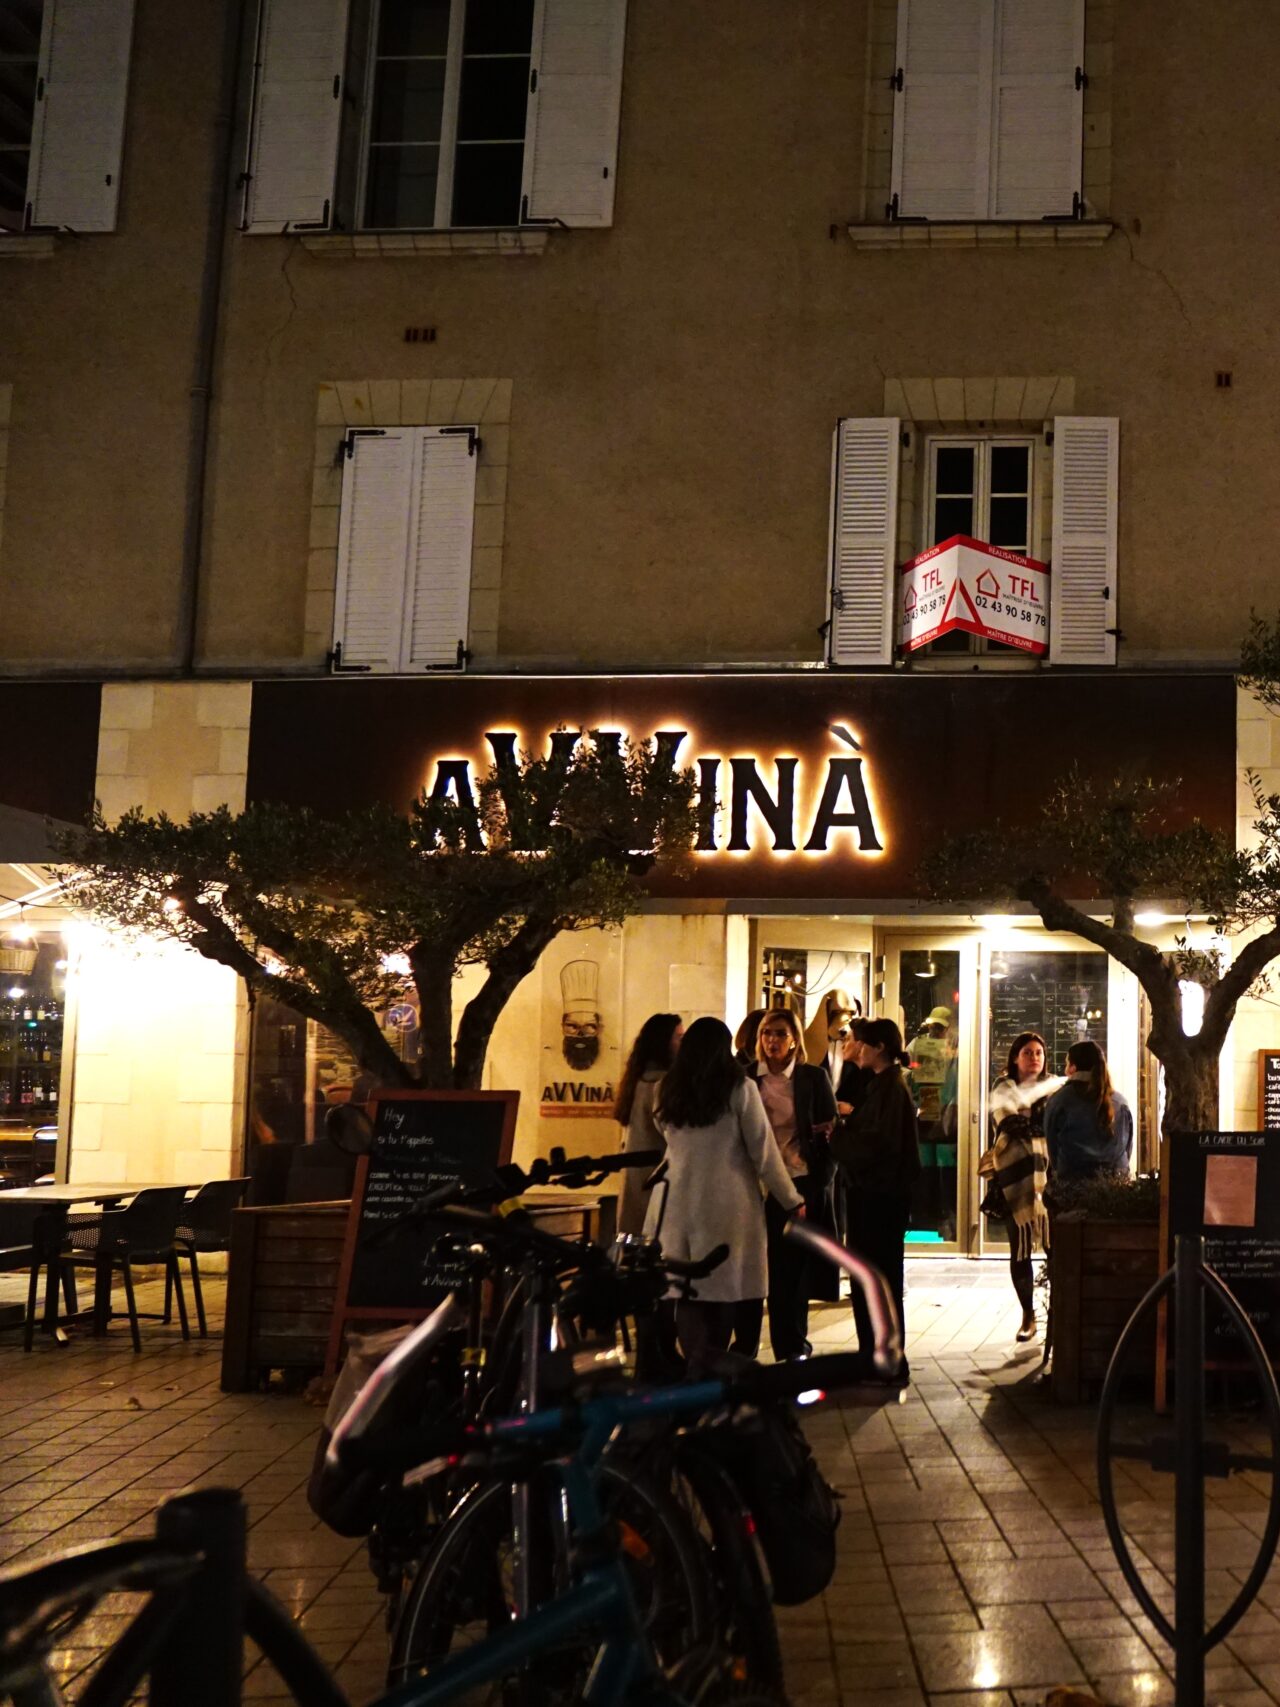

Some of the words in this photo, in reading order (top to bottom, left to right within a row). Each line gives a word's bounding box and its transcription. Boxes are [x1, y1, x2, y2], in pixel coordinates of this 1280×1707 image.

[988, 547, 1027, 566] RÉALISATION
[922, 568, 942, 592] TFL
[1008, 574, 1039, 602] TFL
[912, 609, 918, 620] 43
[920, 604, 927, 615] 90
[930, 599, 936, 612] 58
[939, 594, 946, 606] 78
[975, 595, 988, 609] 02
[991, 601, 1002, 612] 43
[1006, 606, 1017, 618] 90
[1020, 610, 1032, 622] 58
[1034, 614, 1046, 626] 78
[987, 629, 1007, 640] MAÎTRE
[541, 1082, 614, 1102] AVVINÀ
[384, 1108, 405, 1129] Hey
